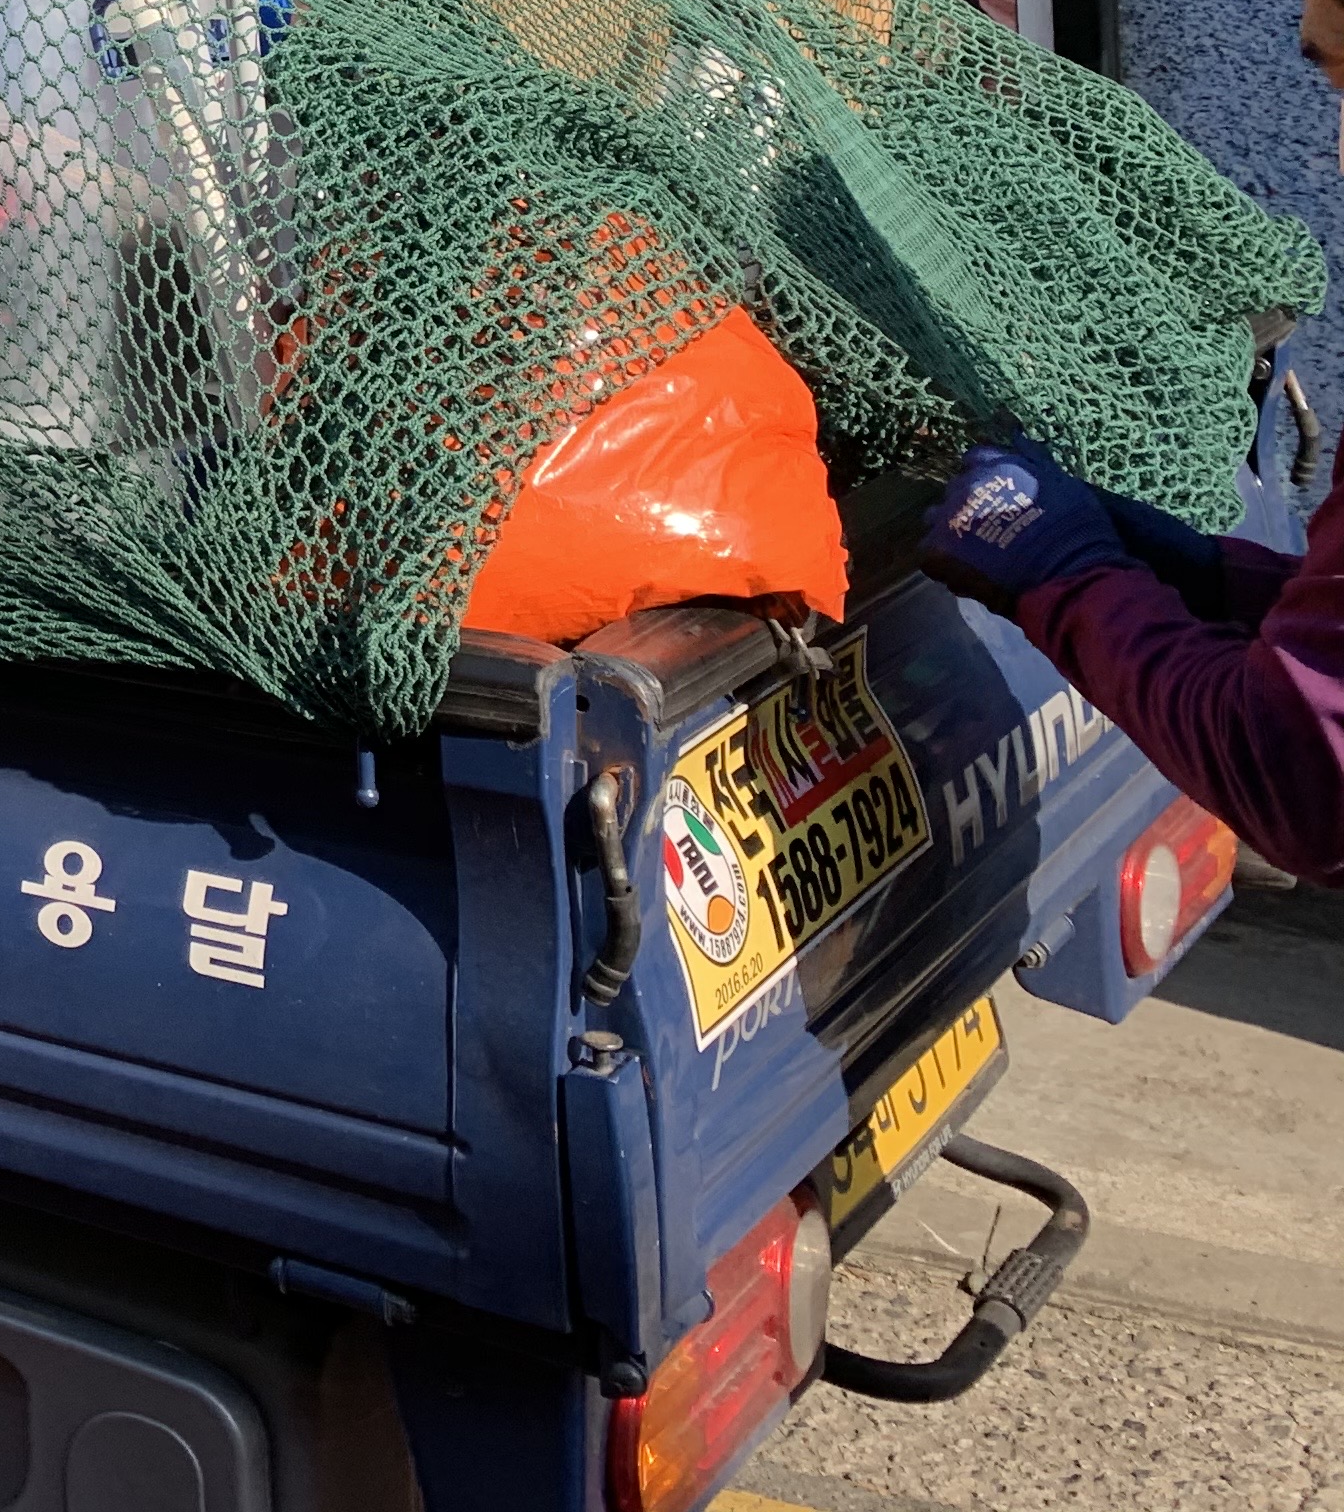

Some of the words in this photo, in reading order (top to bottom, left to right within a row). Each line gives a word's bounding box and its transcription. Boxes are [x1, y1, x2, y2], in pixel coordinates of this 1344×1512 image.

[756, 761, 920, 954] 1588-7924
[943, 683, 1115, 867] HYUND
[714, 951, 764, 1010] 2016.6.20
